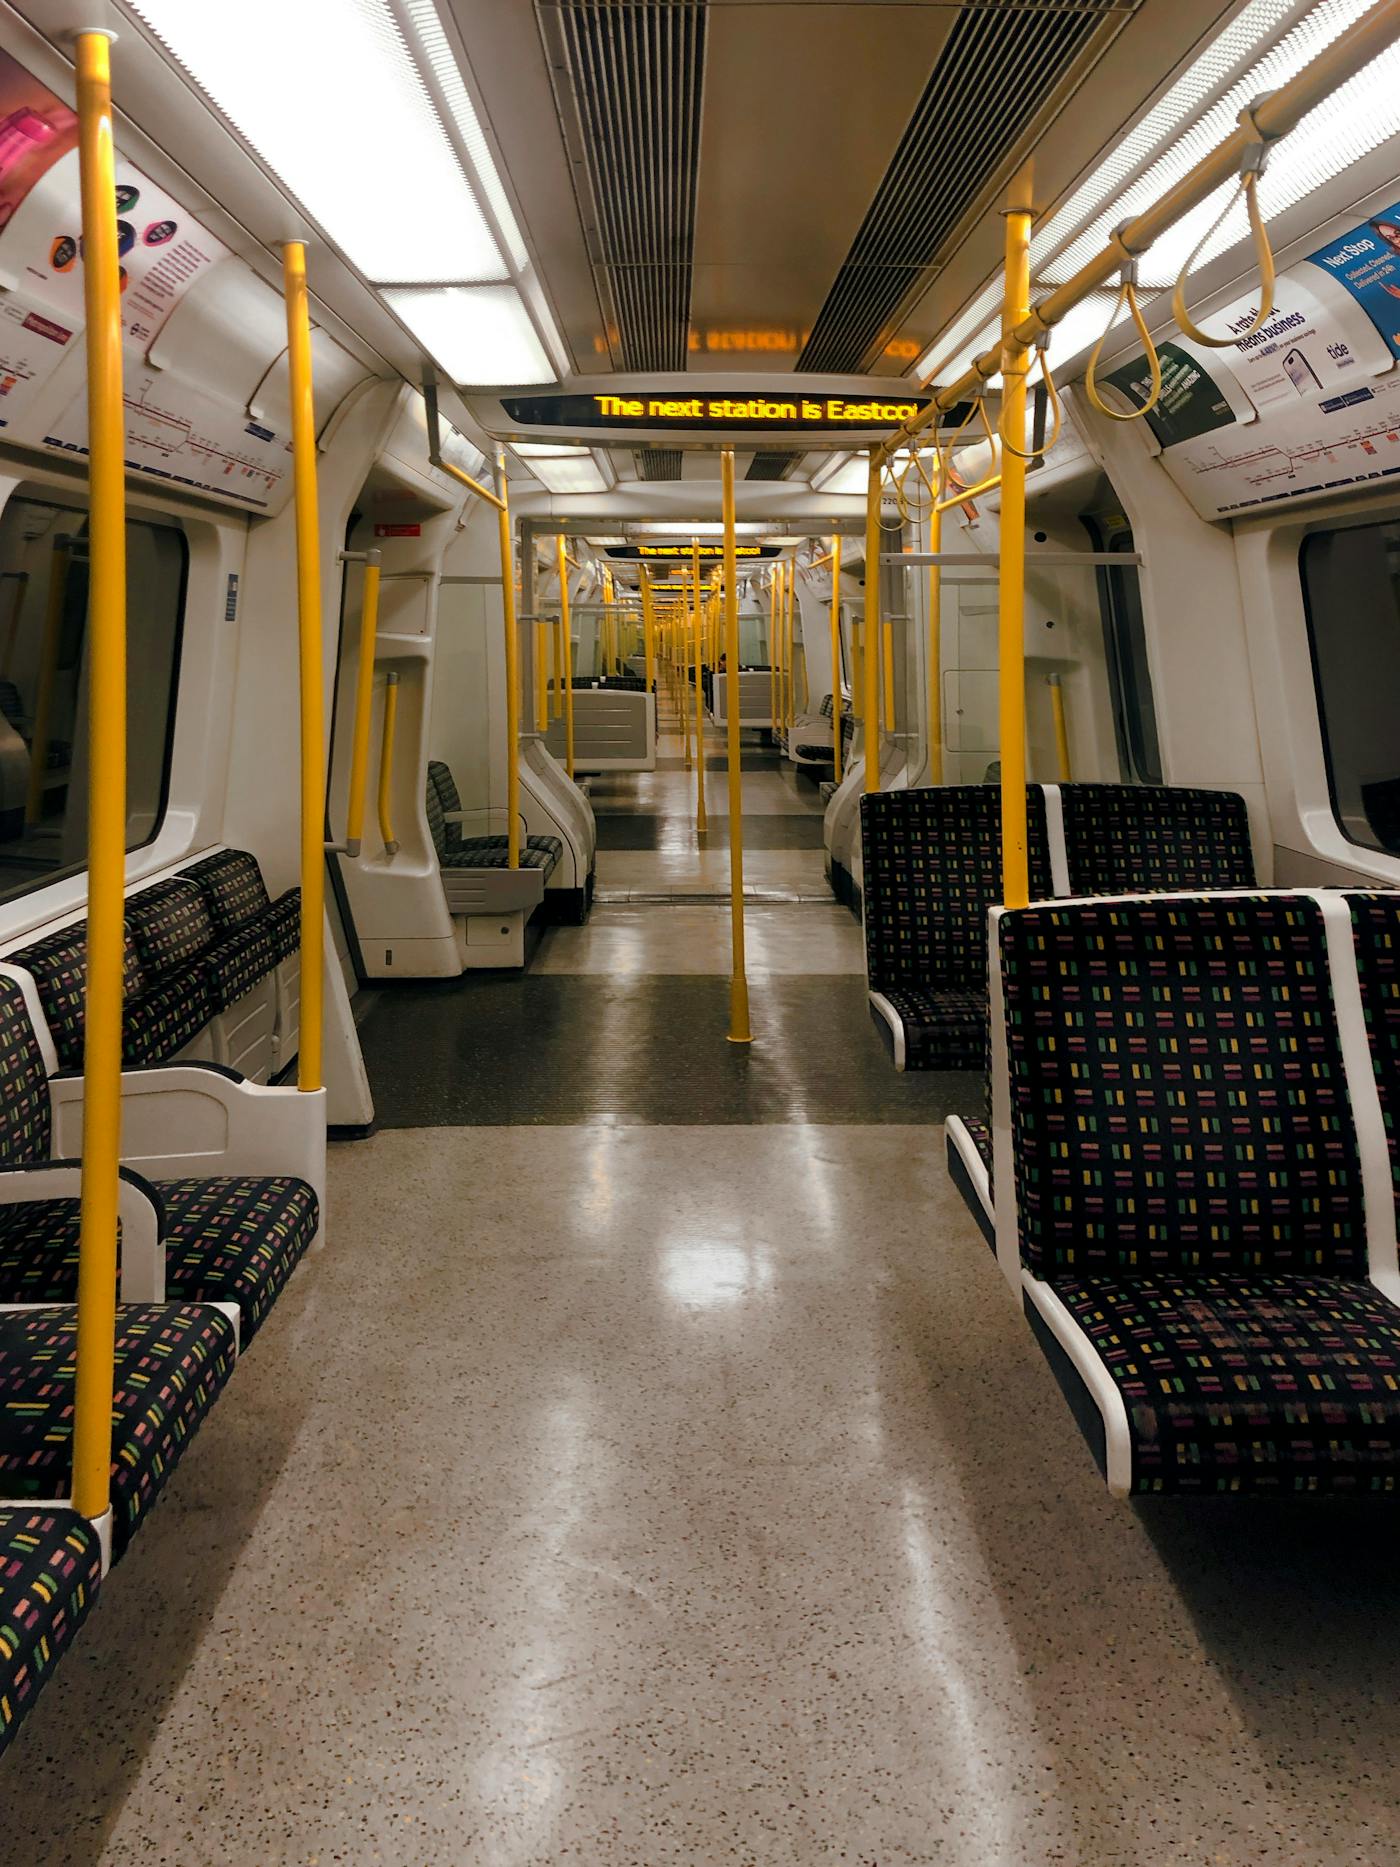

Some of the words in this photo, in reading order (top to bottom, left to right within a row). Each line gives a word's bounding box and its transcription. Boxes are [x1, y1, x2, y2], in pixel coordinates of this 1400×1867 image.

[1323, 248, 1354, 268] Next
[1343, 239, 1376, 256] Stop
[1226, 323, 1242, 335] A
[1236, 332, 1267, 353] means
[1260, 312, 1306, 339] business
[1326, 342, 1350, 360] tide
[594, 396, 644, 416] The
[649, 399, 704, 417] next
[709, 399, 797, 419] station
[802, 400, 822, 419] is
